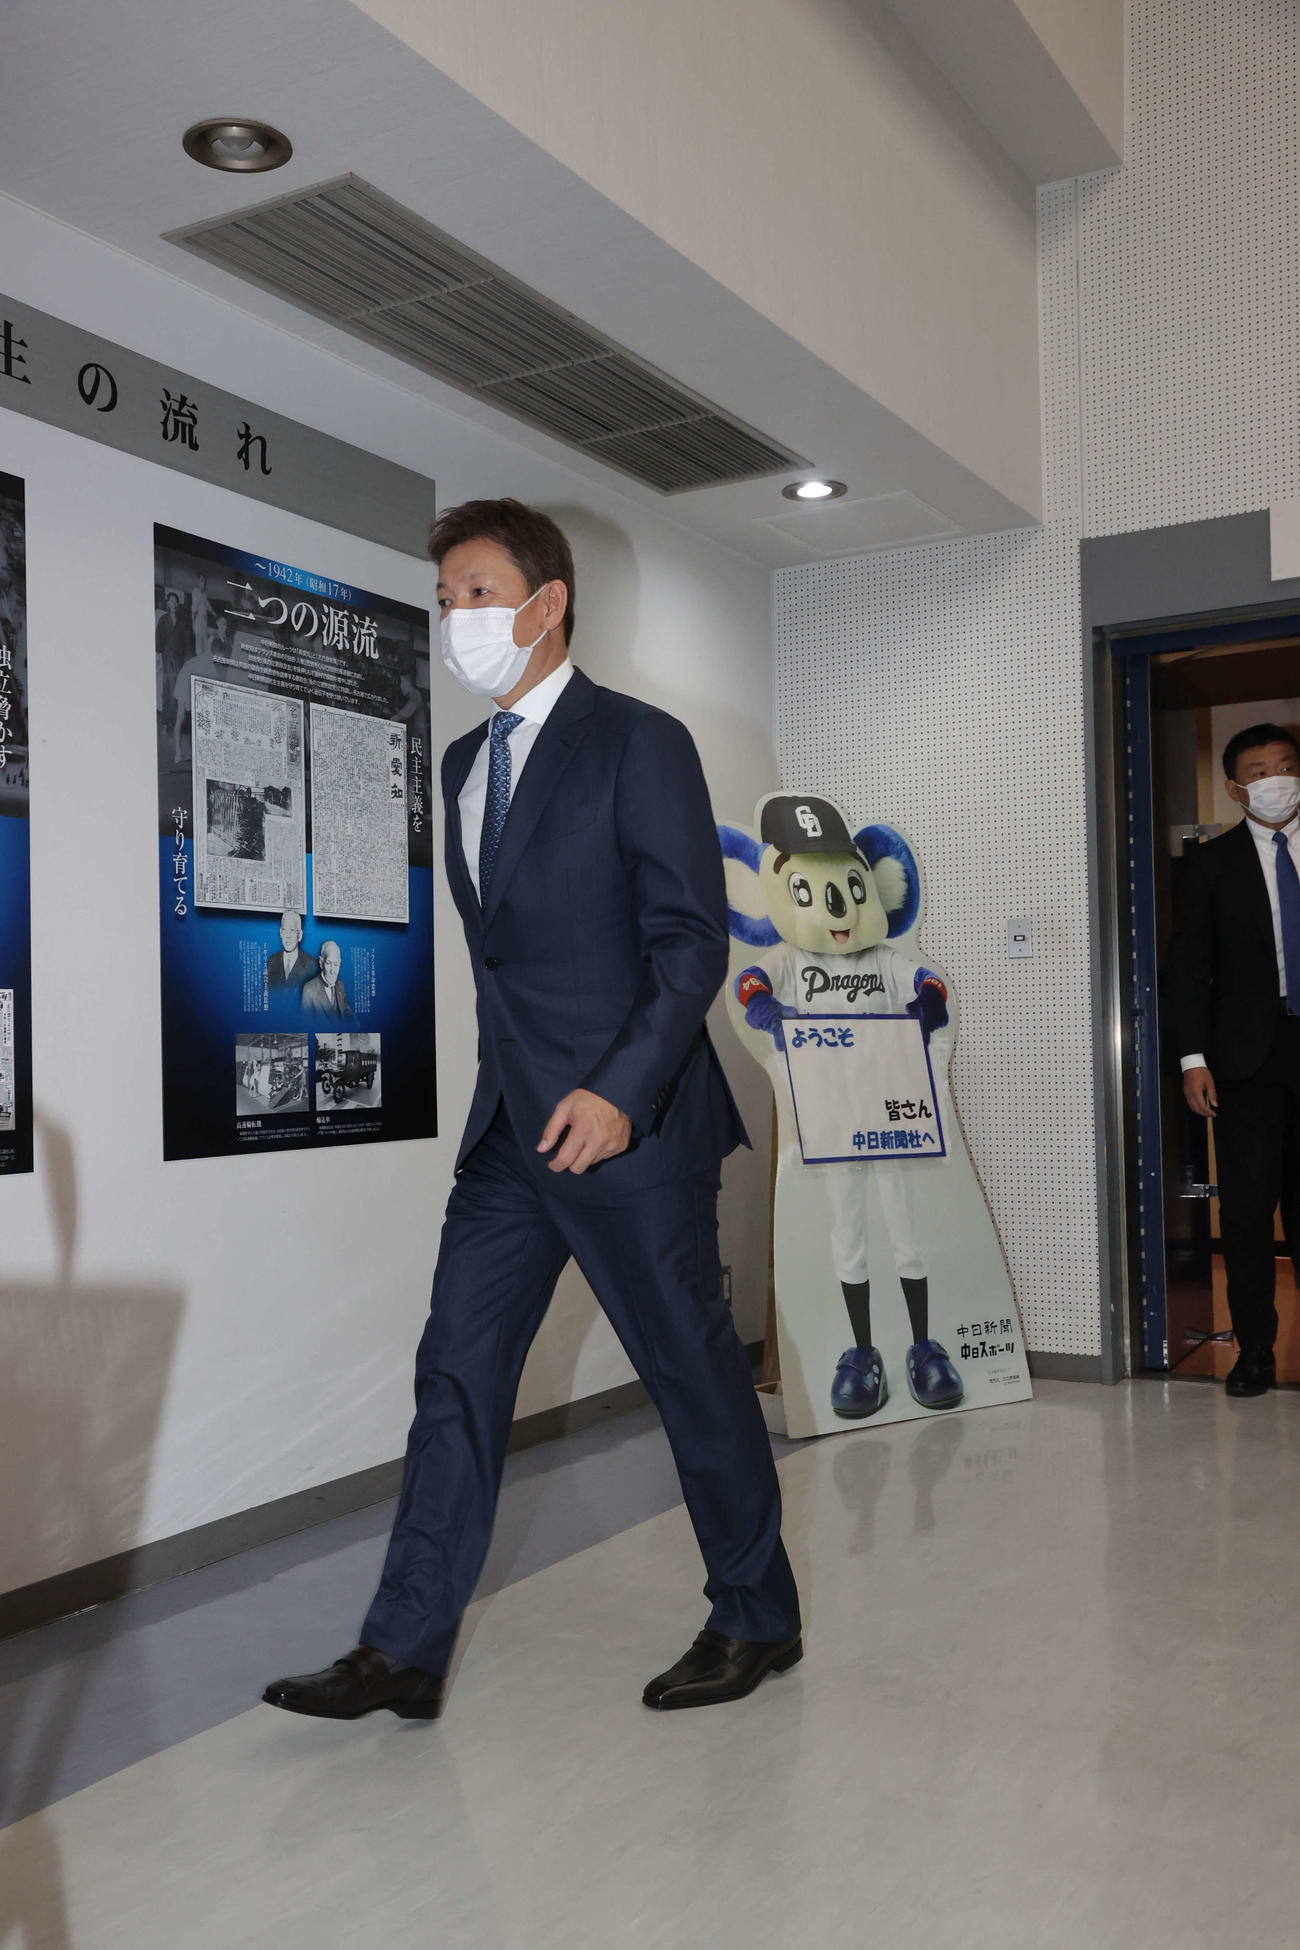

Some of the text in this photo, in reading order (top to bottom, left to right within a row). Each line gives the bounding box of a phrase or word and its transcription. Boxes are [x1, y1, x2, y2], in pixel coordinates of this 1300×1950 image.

[223, 578, 380, 660] 二つの源流
[410, 736, 424, 833] 民主主義を
[171, 806, 188, 916] 守り育てる
[801, 966, 886, 1003] Dragons
[792, 1027, 855, 1048] ようこそ
[885, 1099, 932, 1122] 皆さん
[852, 1129, 936, 1151] 中日新聞社へ
[956, 1319, 1013, 1338] 中日新聞
[961, 1341, 1014, 1360] 中日スポーツ
